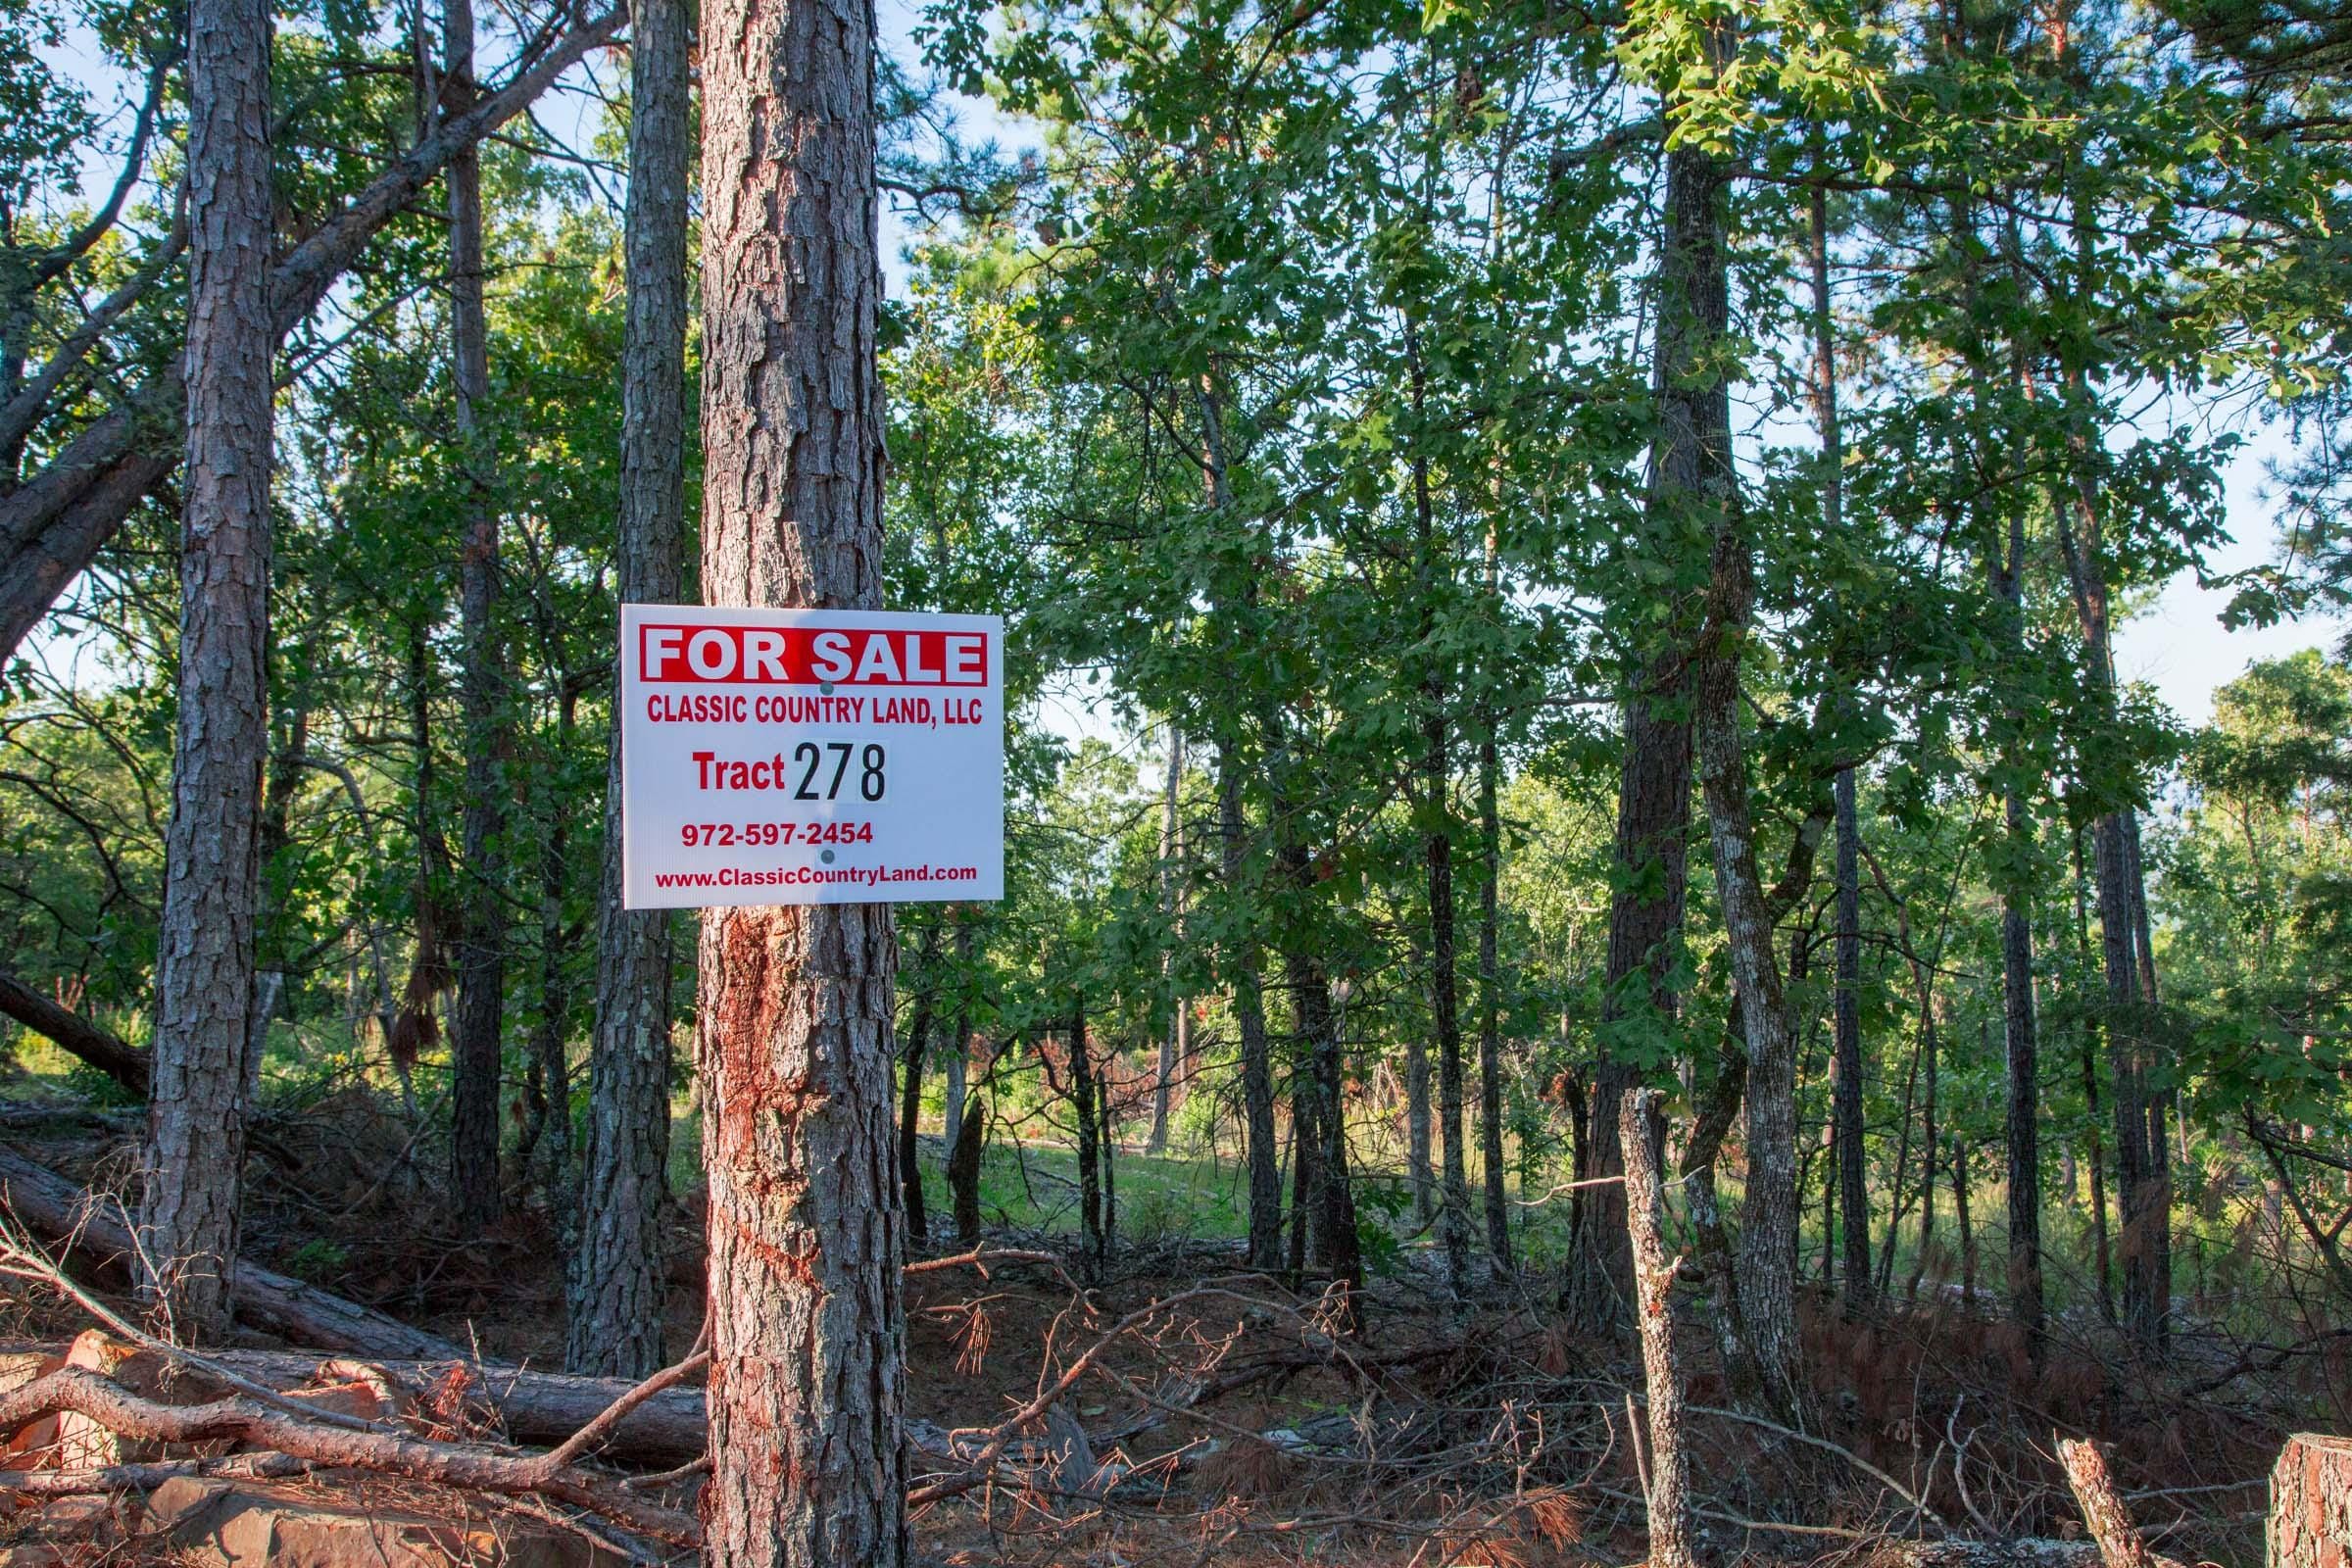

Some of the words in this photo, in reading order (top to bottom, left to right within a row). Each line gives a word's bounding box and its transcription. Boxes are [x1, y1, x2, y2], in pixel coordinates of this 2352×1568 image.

[645, 628, 790, 682] FOR
[810, 632, 981, 683] SALE
[647, 694, 747, 723] CLASSIC
[755, 695, 865, 723] COUNTRY
[872, 697, 937, 730] LAND,
[944, 698, 983, 724] LLC
[692, 751, 785, 790] Tract
[793, 741, 886, 802] 278
[681, 822, 873, 847] 972-597-2454
[655, 864, 977, 888] www.ClassicCountryLand.com
